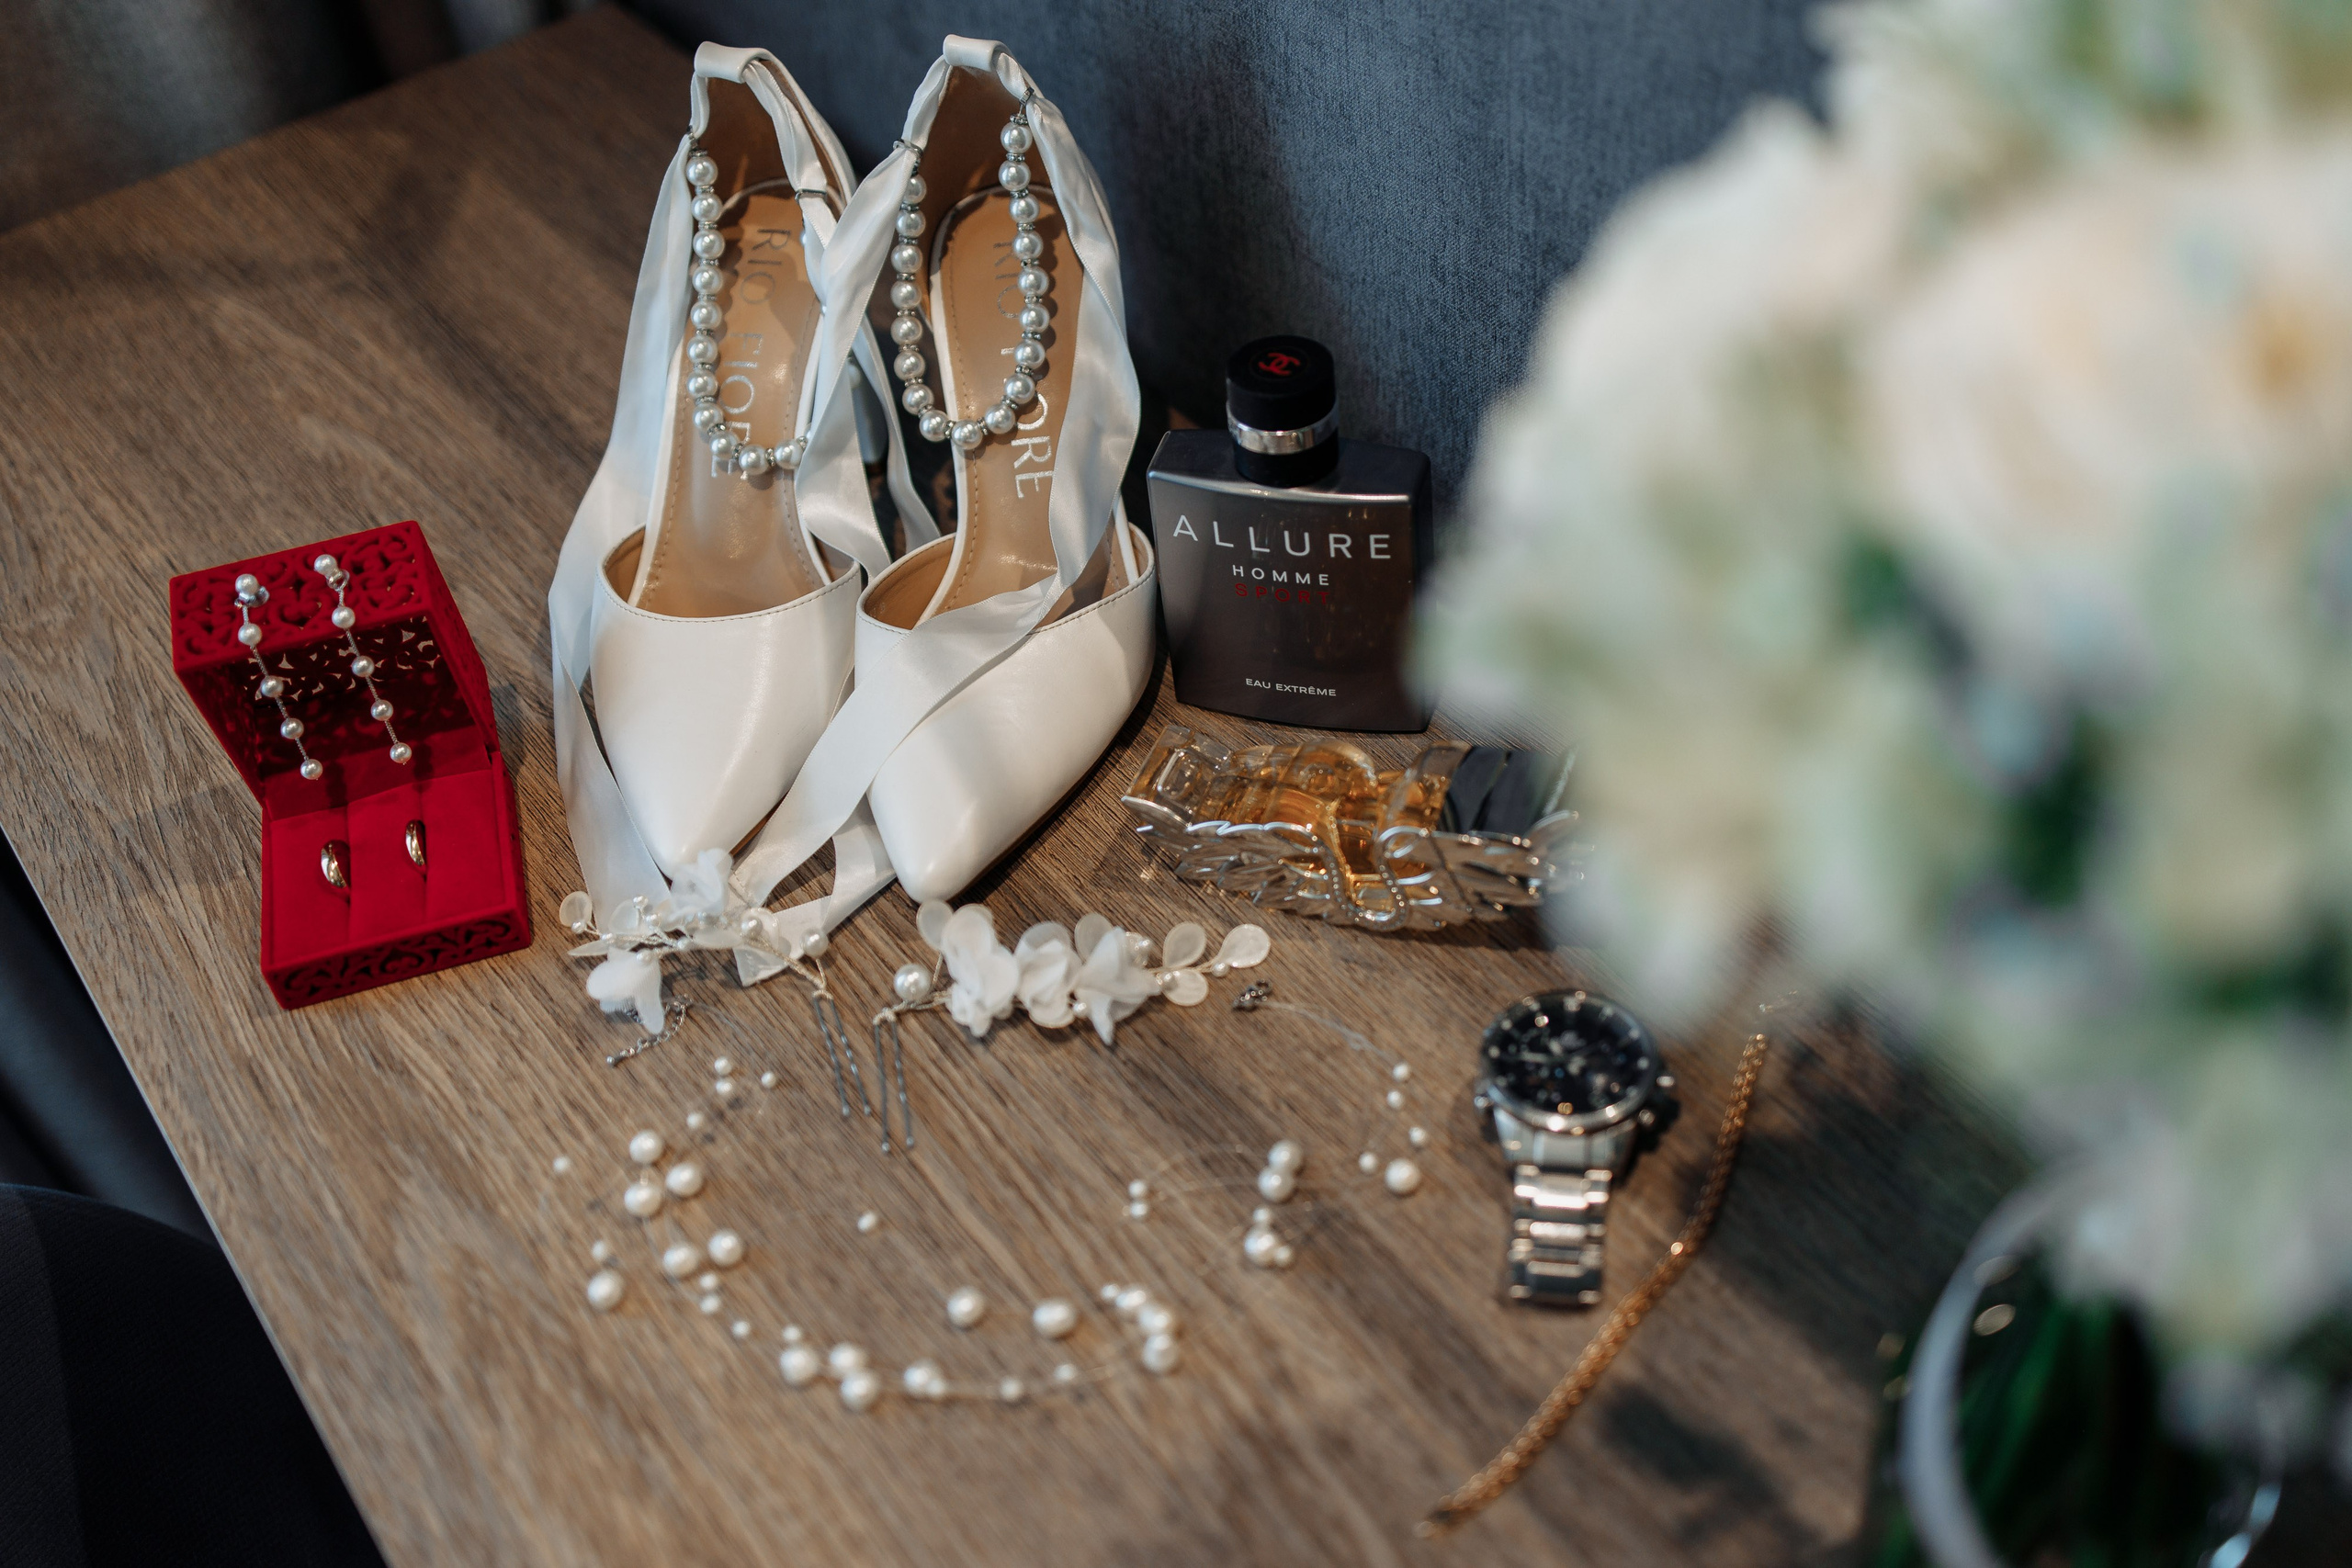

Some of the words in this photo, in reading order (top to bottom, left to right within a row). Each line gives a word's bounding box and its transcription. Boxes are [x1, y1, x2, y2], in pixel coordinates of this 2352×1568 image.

[741, 229, 791, 304] RIO
[1001, 347, 1054, 499] ORE
[1172, 514, 1391, 559] ALLURE
[1232, 565, 1329, 586] HOMME
[1235, 583, 1331, 604] SPORT
[1245, 678, 1272, 690] EAU
[1275, 682, 1337, 696] EXTRÊME
